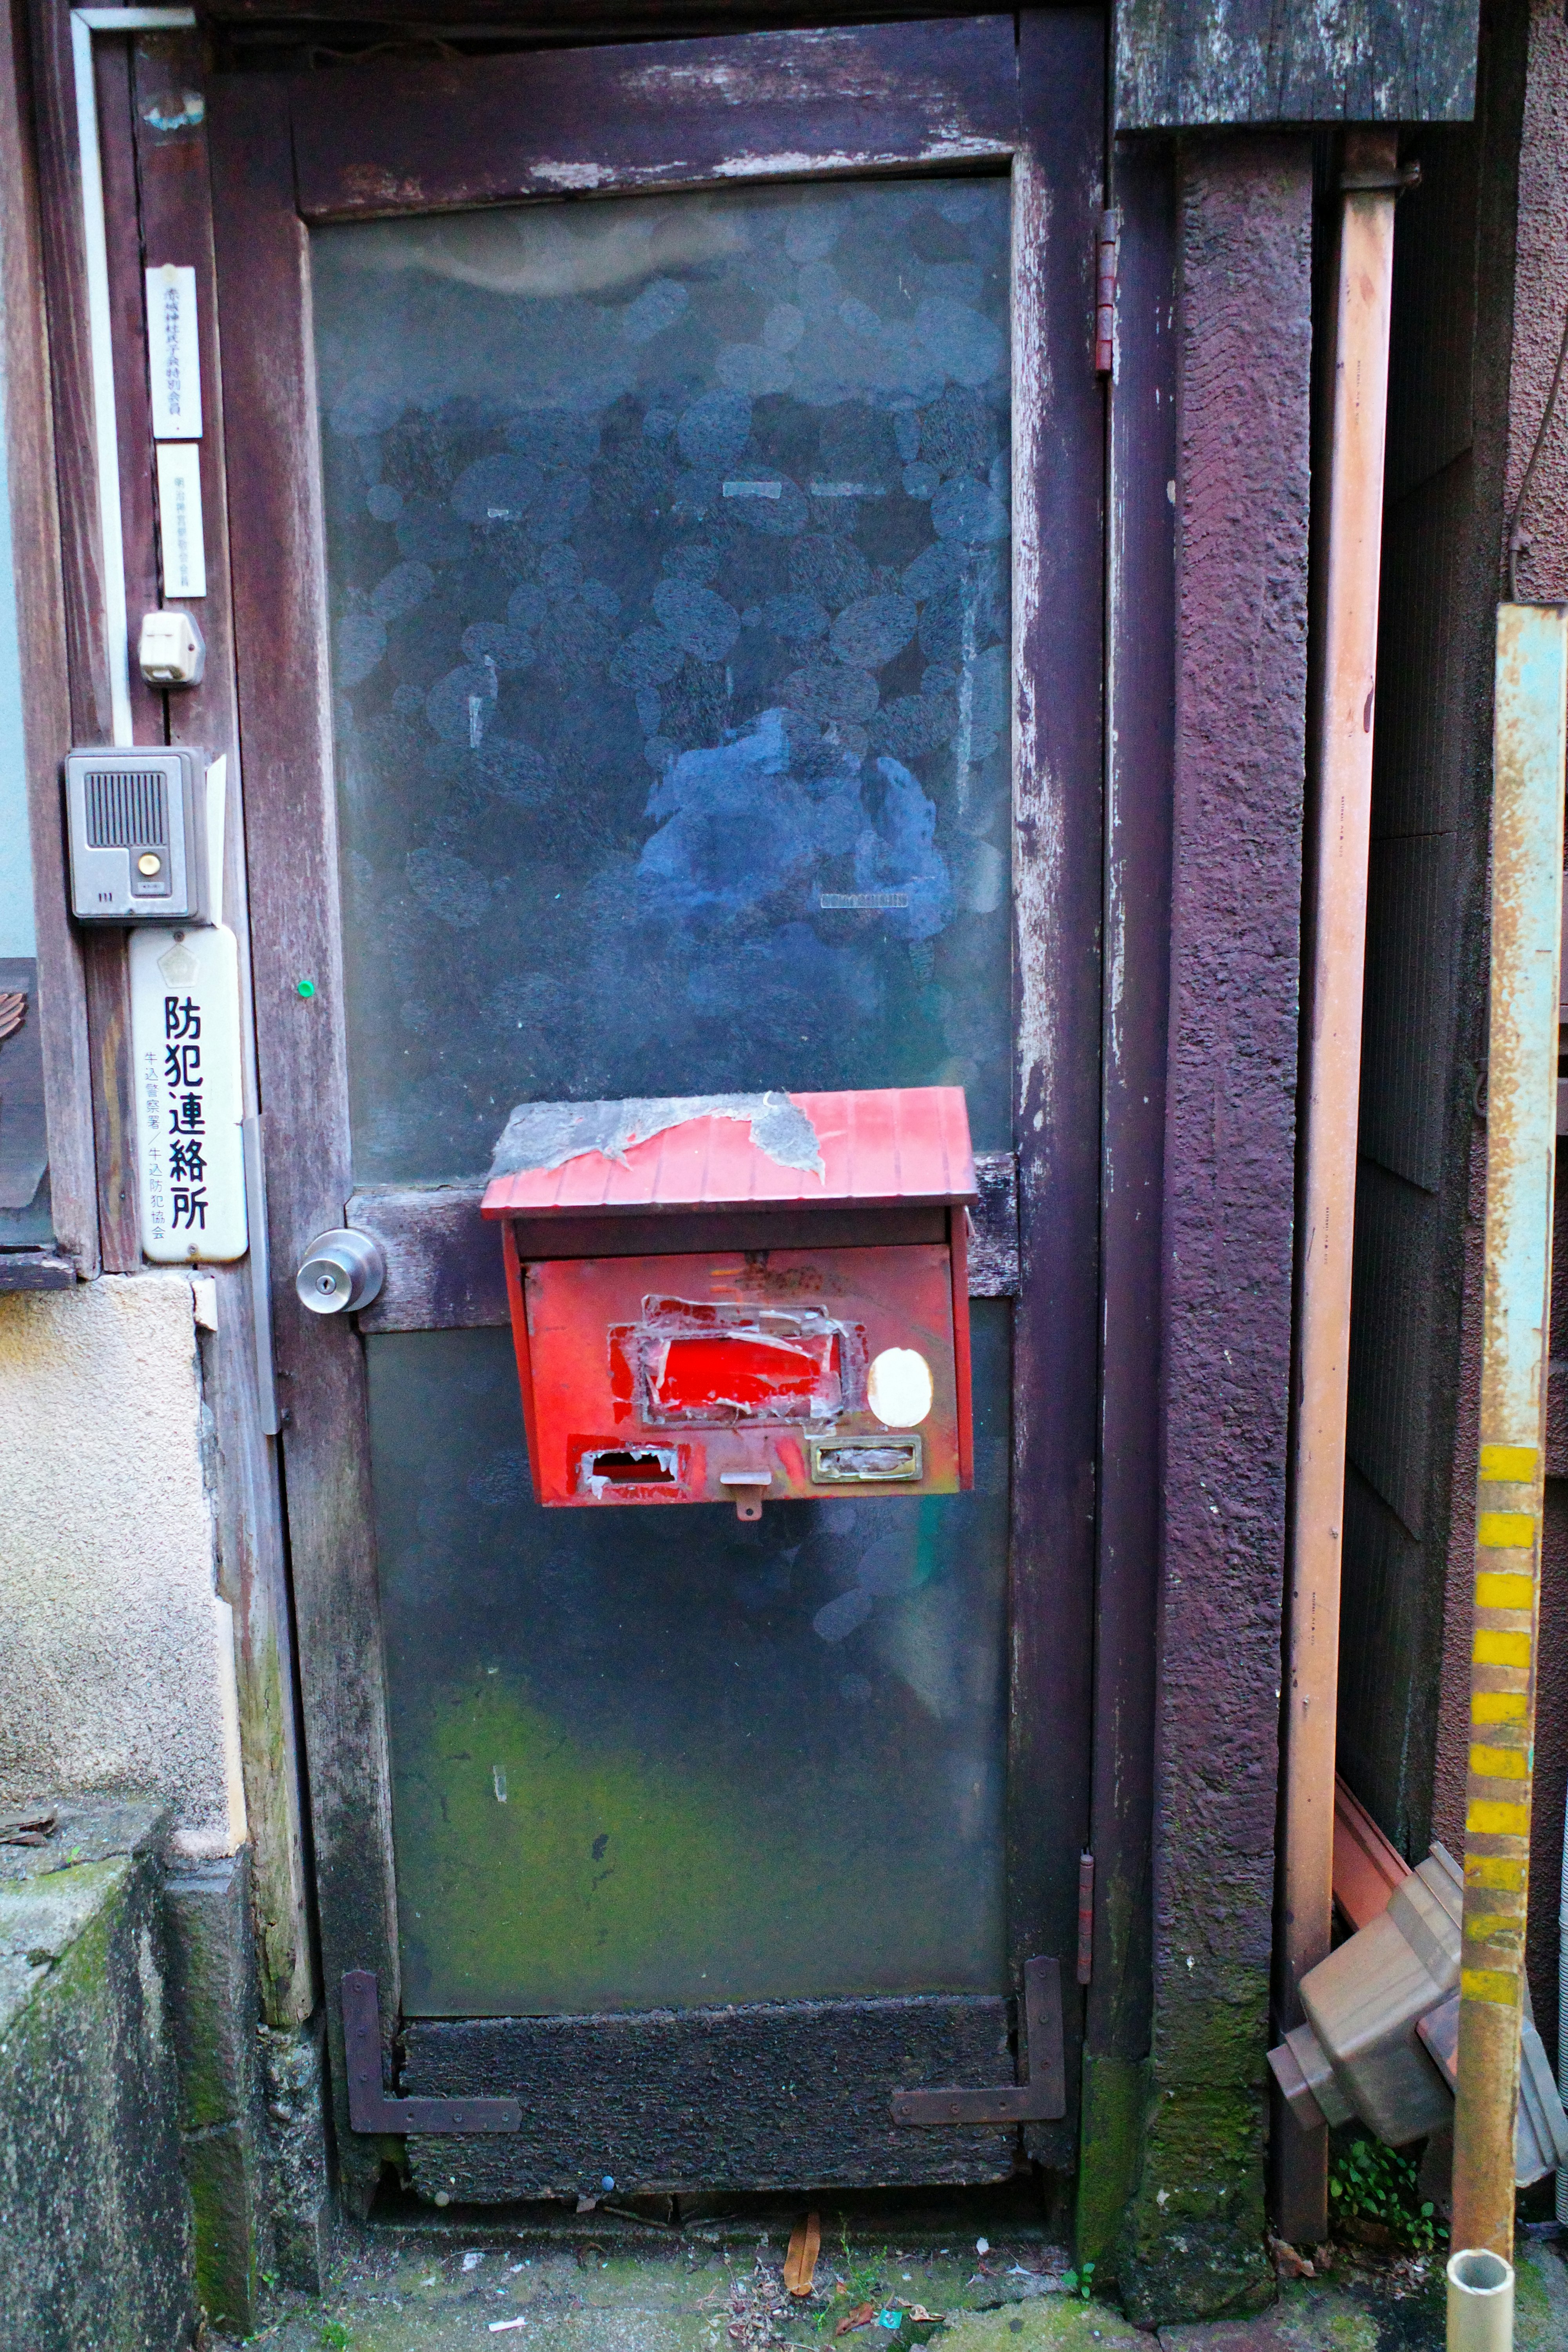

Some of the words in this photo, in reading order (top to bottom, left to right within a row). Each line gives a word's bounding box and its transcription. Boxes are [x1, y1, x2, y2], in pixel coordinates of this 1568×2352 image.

[164, 996, 209, 1230] 防犯連絡所
